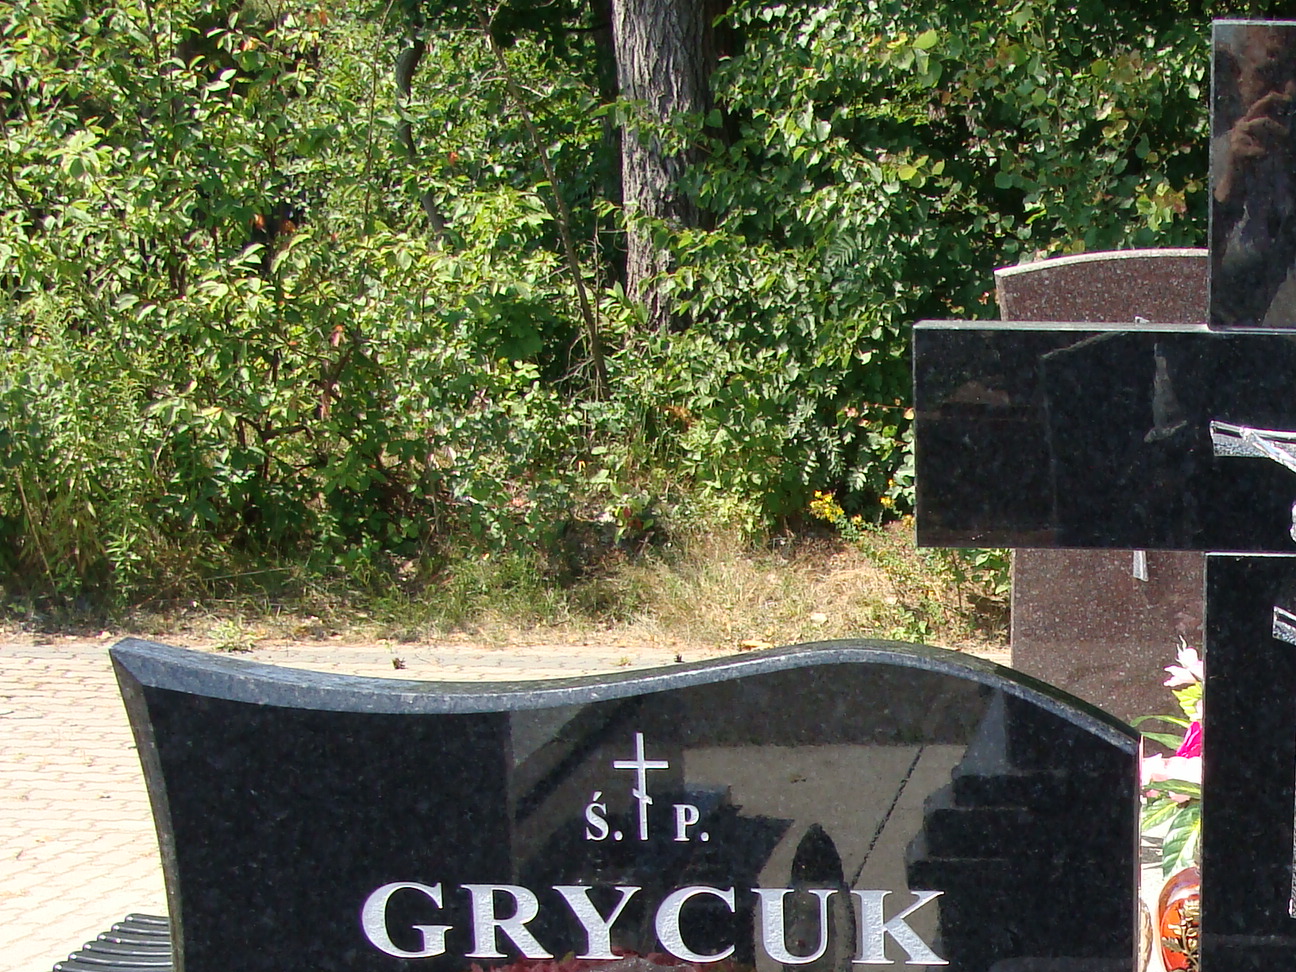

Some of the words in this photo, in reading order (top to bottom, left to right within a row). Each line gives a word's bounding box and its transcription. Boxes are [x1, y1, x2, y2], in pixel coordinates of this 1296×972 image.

[585, 791, 623, 841] Ś.
[674, 804, 709, 842] P.
[361, 881, 949, 965] GRYCUK
